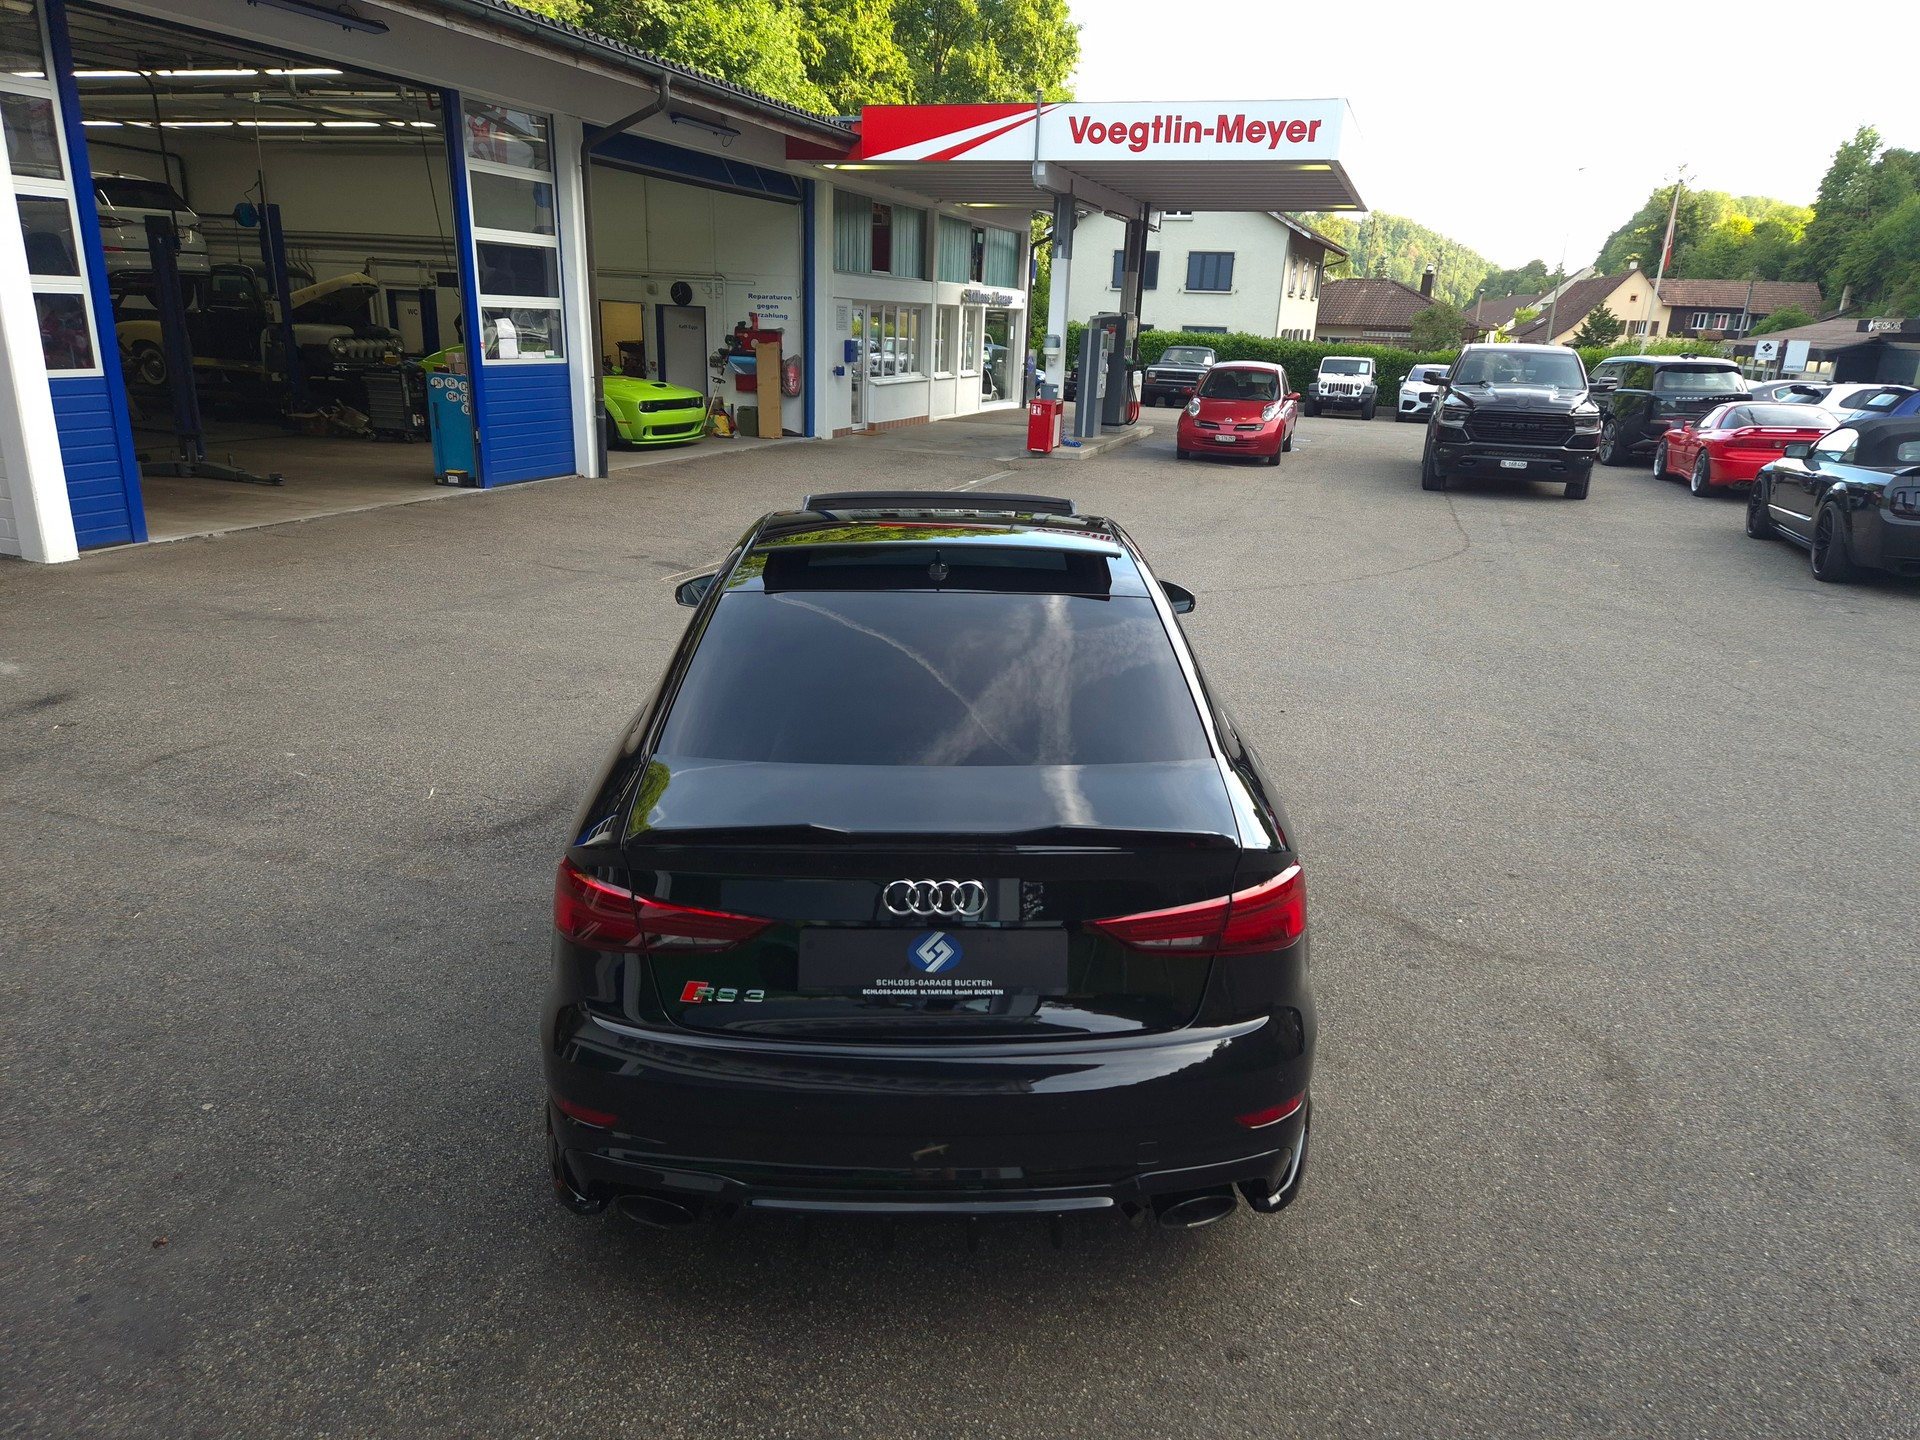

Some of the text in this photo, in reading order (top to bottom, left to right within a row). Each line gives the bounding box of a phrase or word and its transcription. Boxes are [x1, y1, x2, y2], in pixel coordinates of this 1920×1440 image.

[1069, 114, 1322, 153] Voegtlin-Meyer
[748, 293, 792, 301] Reparaturen
[407, 308, 418, 316] WC
[748, 311, 788, 320] Brzahlung
[447, 379, 456, 387] CH
[447, 392, 457, 401] CH
[954, 979, 993, 987] BUCKTEN
